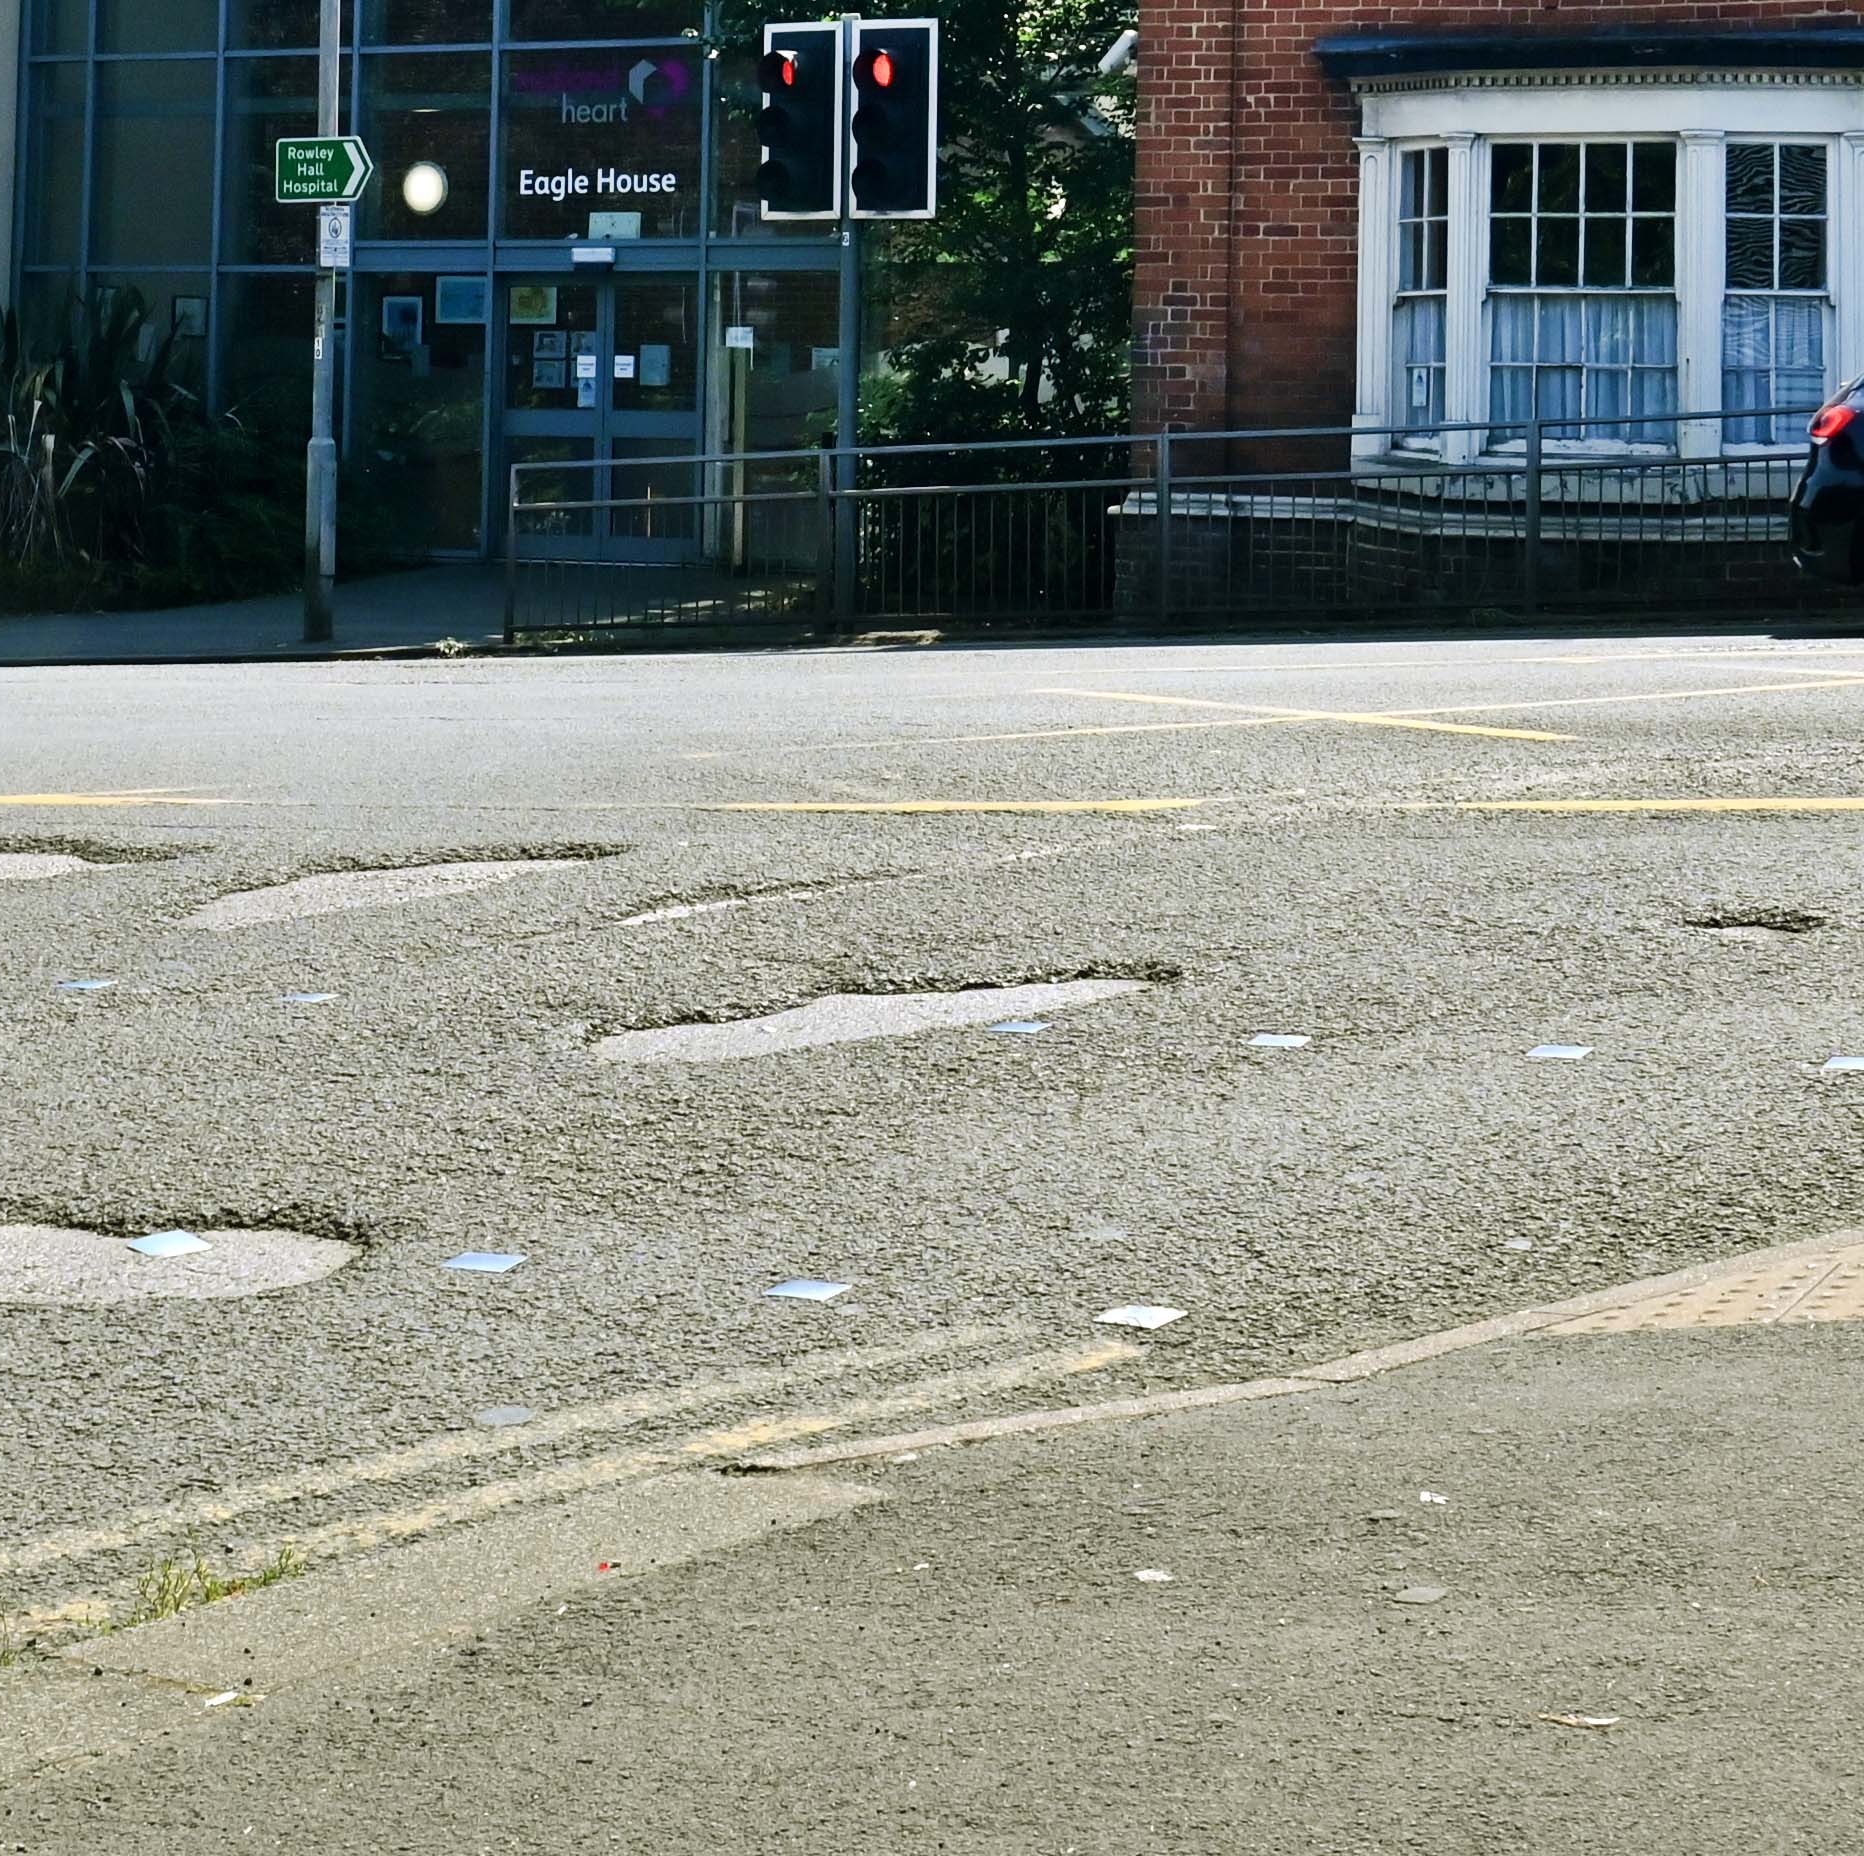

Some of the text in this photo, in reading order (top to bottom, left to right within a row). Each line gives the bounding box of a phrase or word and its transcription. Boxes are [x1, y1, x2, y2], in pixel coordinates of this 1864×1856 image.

[562, 93, 628, 123] heart
[287, 146, 334, 162] Rowley
[297, 162, 324, 177] Hall
[283, 178, 338, 195] Hospital
[519, 167, 677, 202] Eagle House
